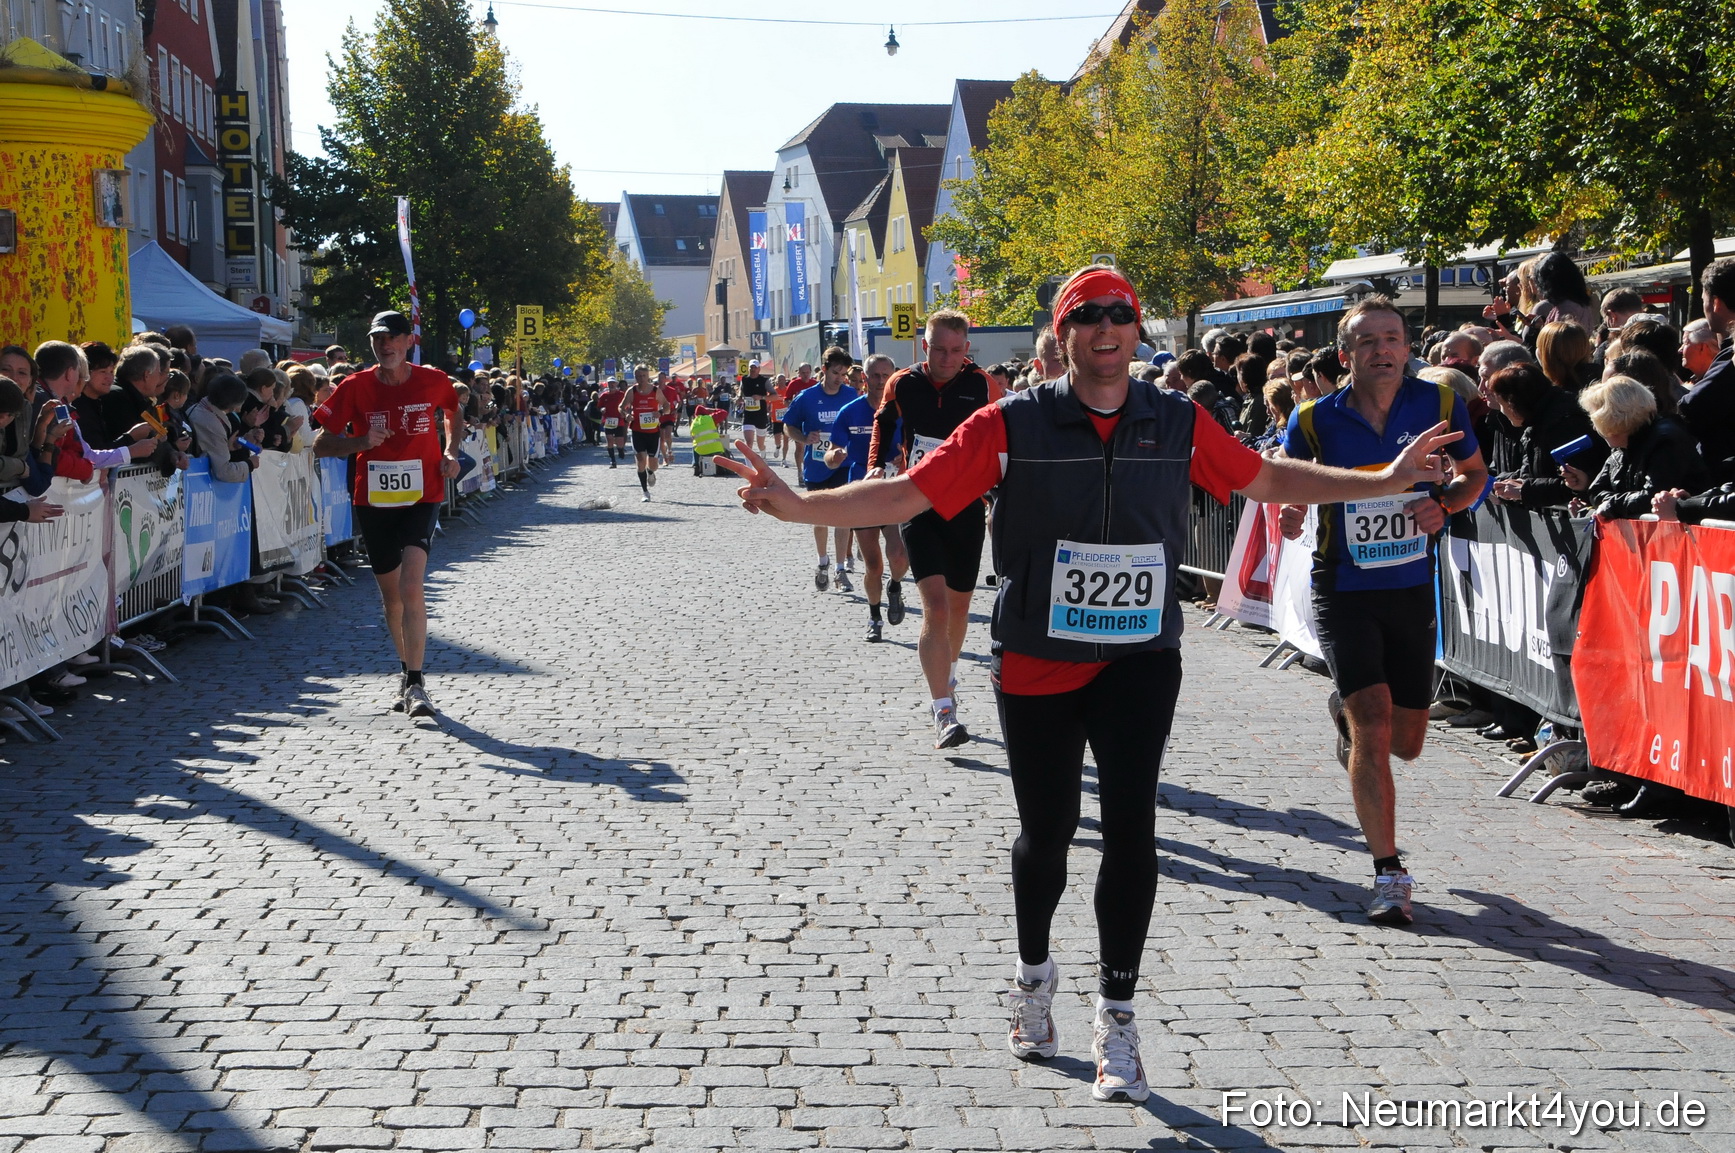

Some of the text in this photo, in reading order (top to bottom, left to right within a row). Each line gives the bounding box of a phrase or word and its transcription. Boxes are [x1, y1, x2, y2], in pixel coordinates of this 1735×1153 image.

[221, 95, 251, 250] HOTEL
[230, 266, 251, 274] Stern
[795, 244, 803, 283] RUPPERT
[520, 306, 541, 315] Block
[895, 304, 914, 312] Block
[523, 317, 537, 336] B
[898, 314, 911, 332] B
[379, 472, 412, 491] 950
[1357, 501, 1395, 510] PFLEIDERER
[1355, 513, 1418, 542] 3201
[1072, 551, 1121, 563] PFLEIDERER
[1358, 538, 1419, 559] Reinhard
[1064, 569, 1153, 607] 3229
[1066, 607, 1148, 630] Clemens
